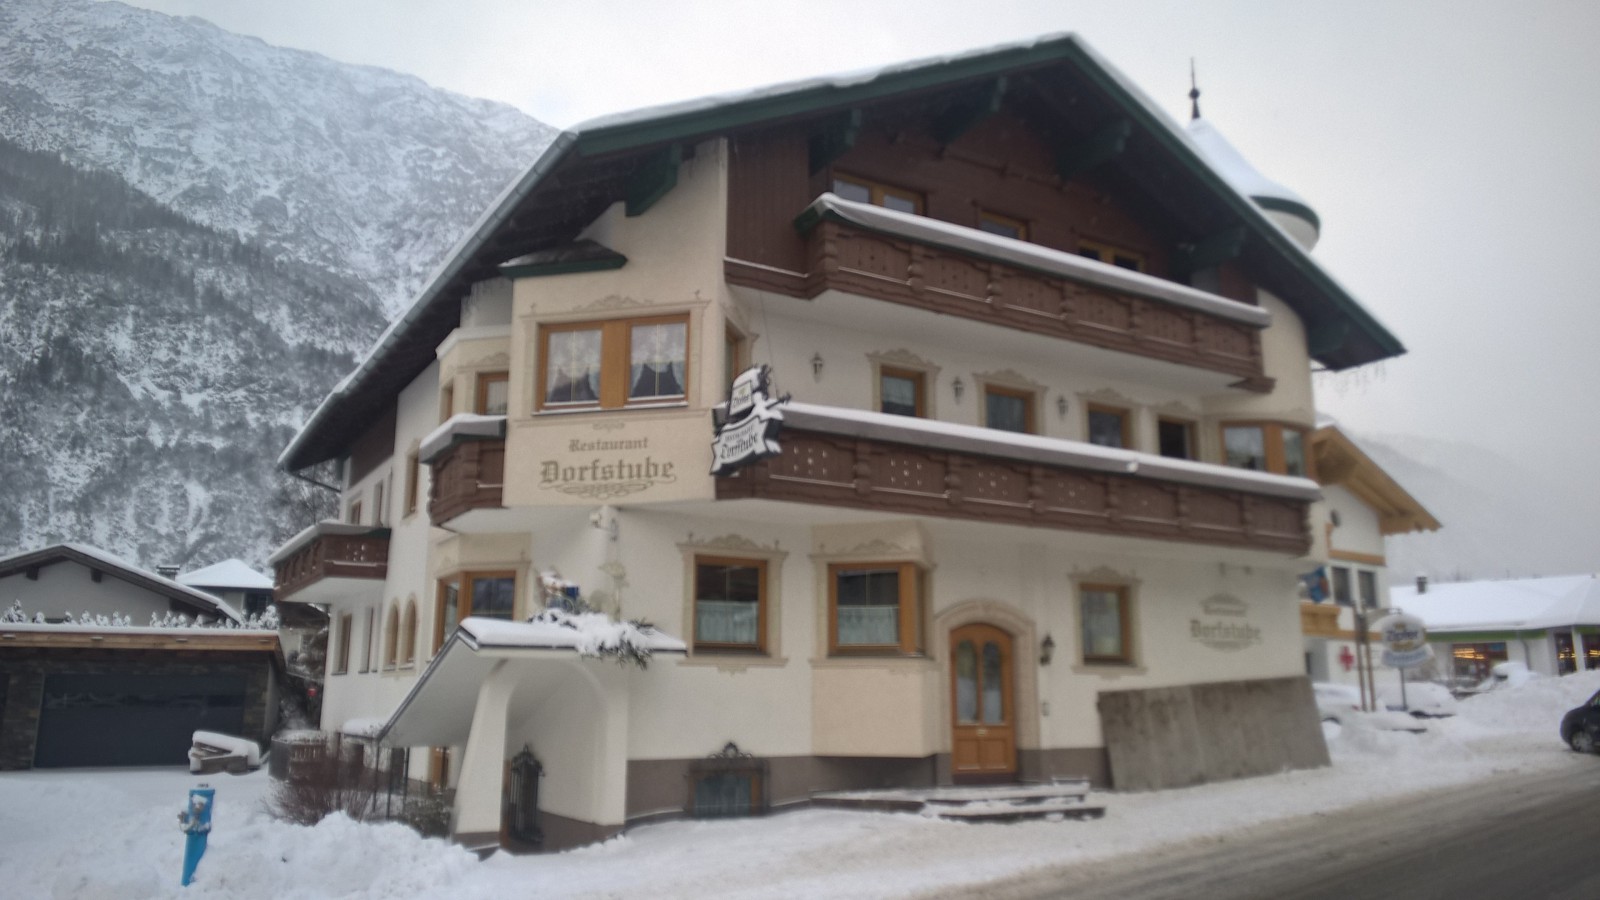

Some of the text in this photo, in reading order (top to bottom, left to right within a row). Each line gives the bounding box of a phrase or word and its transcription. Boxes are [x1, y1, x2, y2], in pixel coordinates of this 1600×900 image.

[568, 437, 648, 452] Restaurant
[540, 456, 675, 483] Dorfstube
[1190, 619, 1261, 640] Dorfstube
